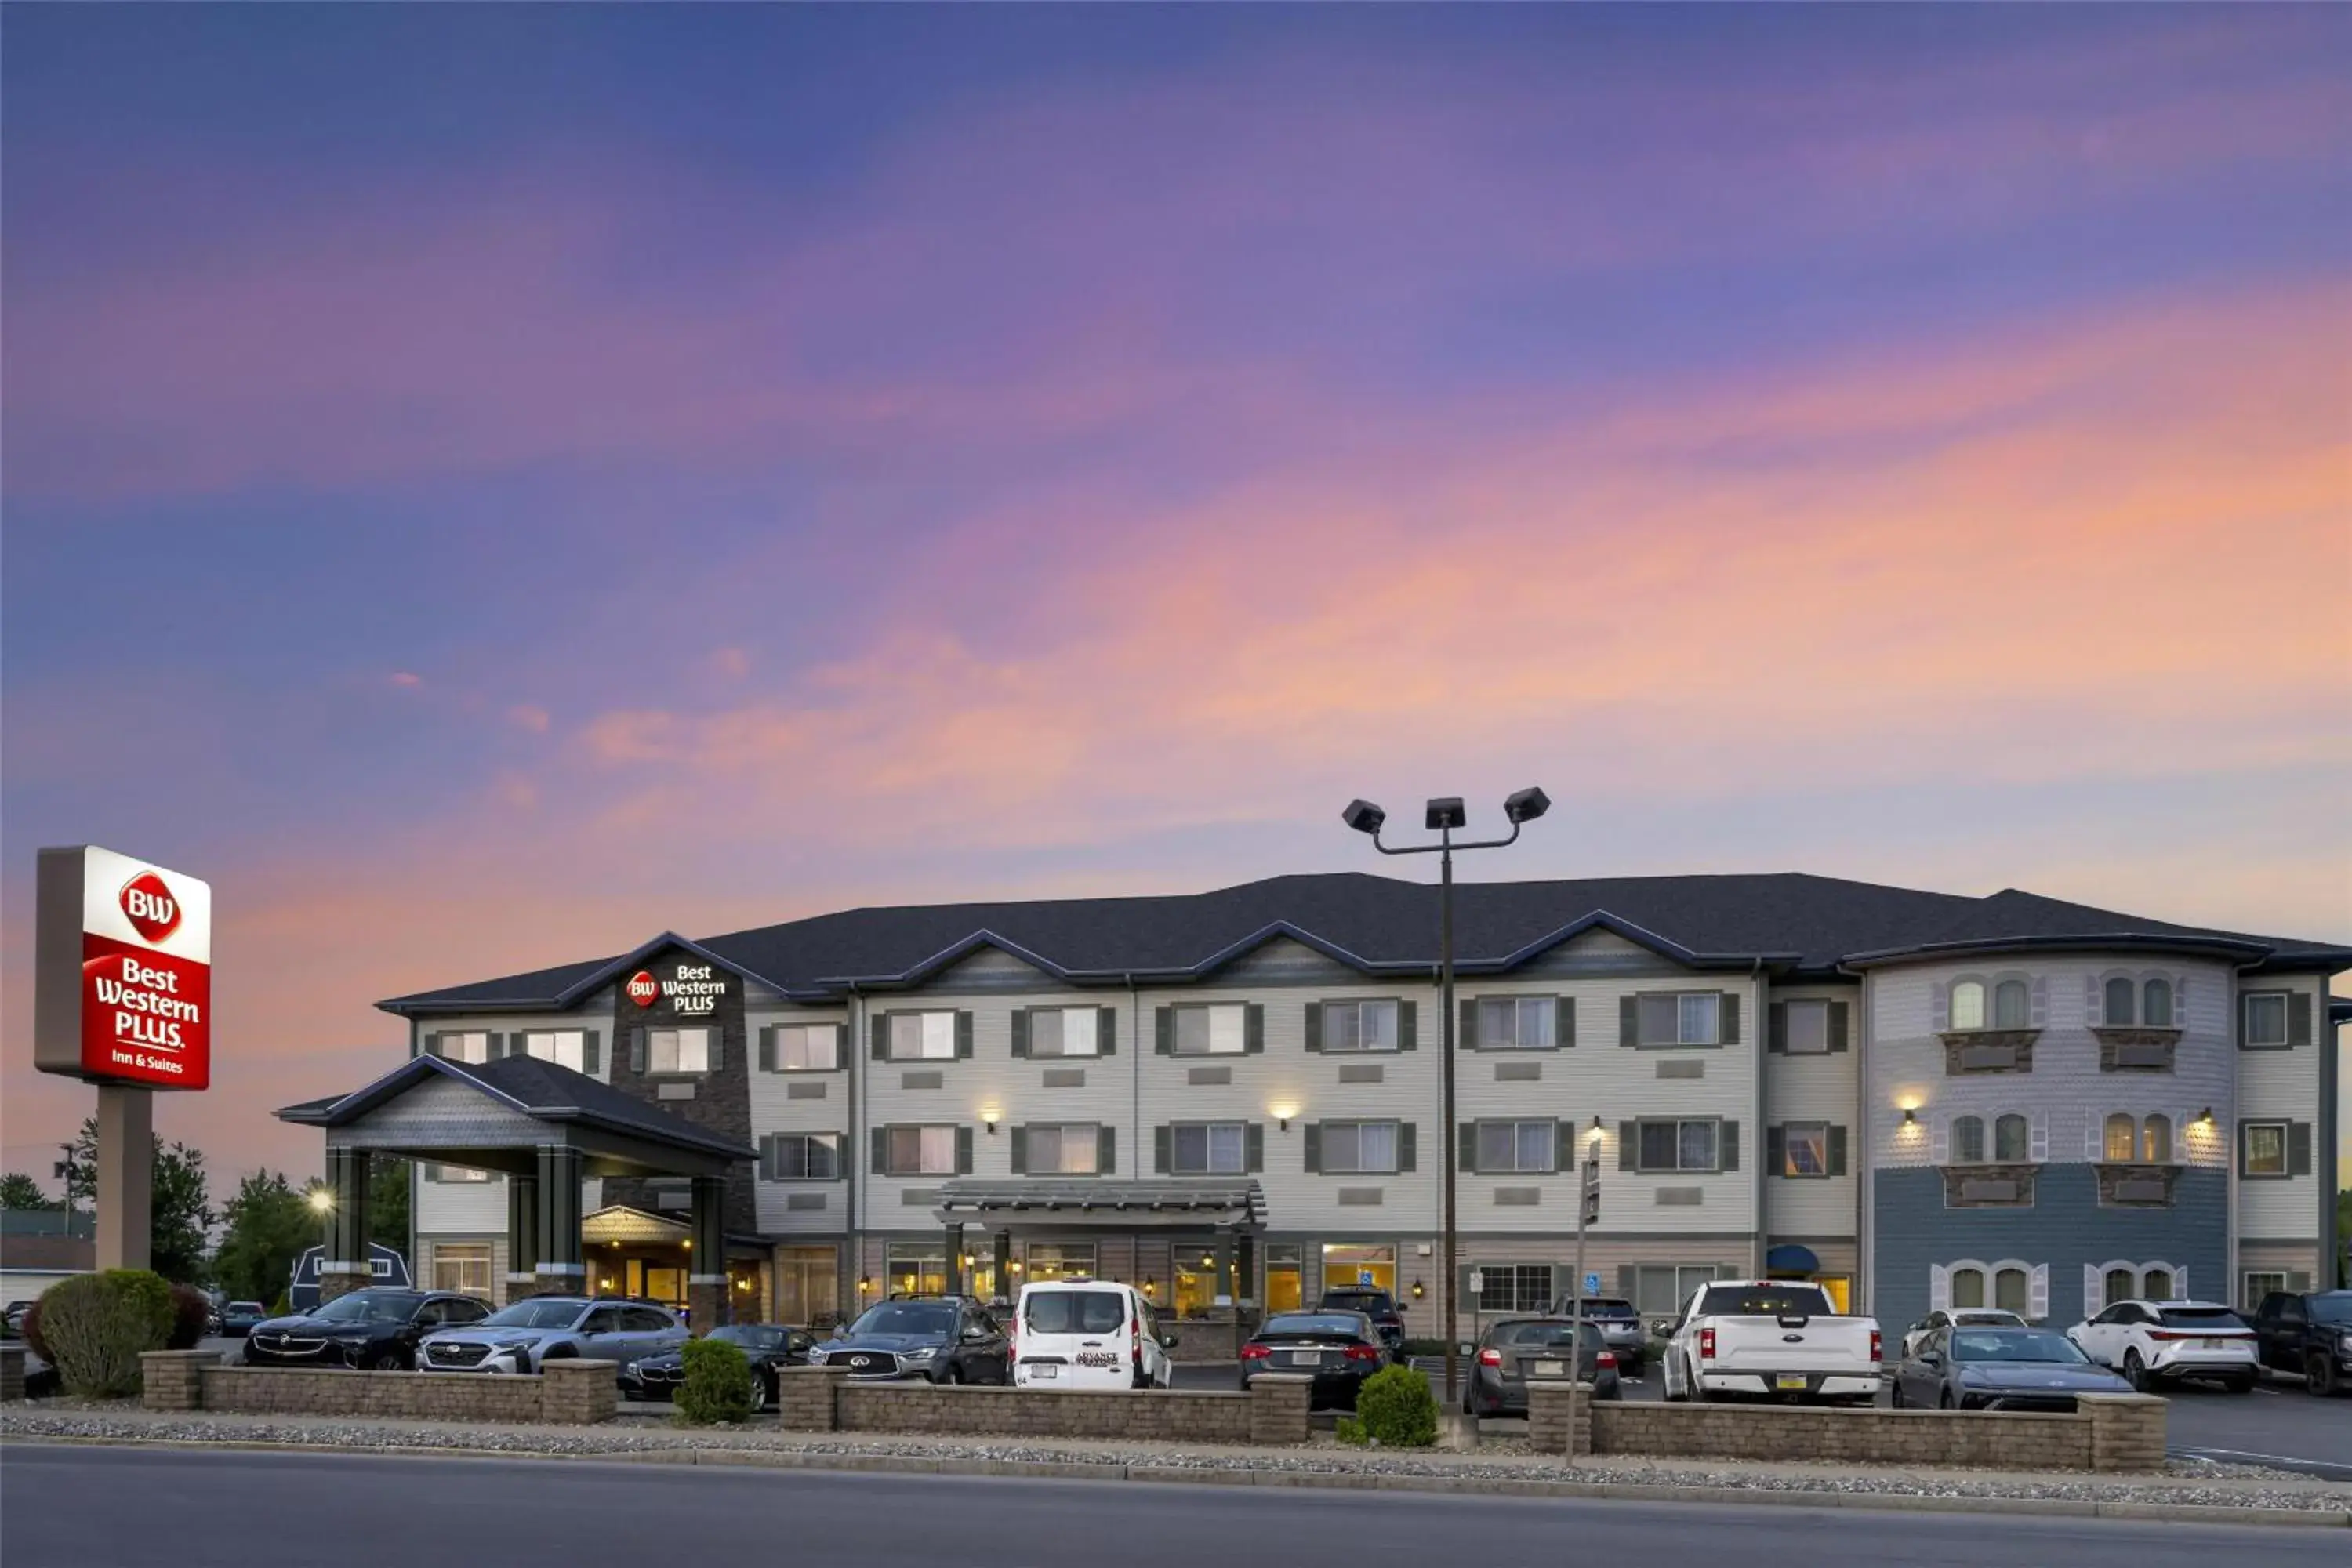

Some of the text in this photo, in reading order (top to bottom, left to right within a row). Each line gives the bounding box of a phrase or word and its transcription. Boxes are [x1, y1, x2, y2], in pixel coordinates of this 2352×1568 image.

[128, 888, 173, 924] BW
[122, 957, 179, 993] Best
[677, 965, 711, 980] Best
[631, 982, 655, 996] BW
[662, 981, 725, 995] Western
[95, 976, 199, 1023] Western
[675, 996, 715, 1011] PLUS
[112, 1049, 183, 1073] Inn & Suites
